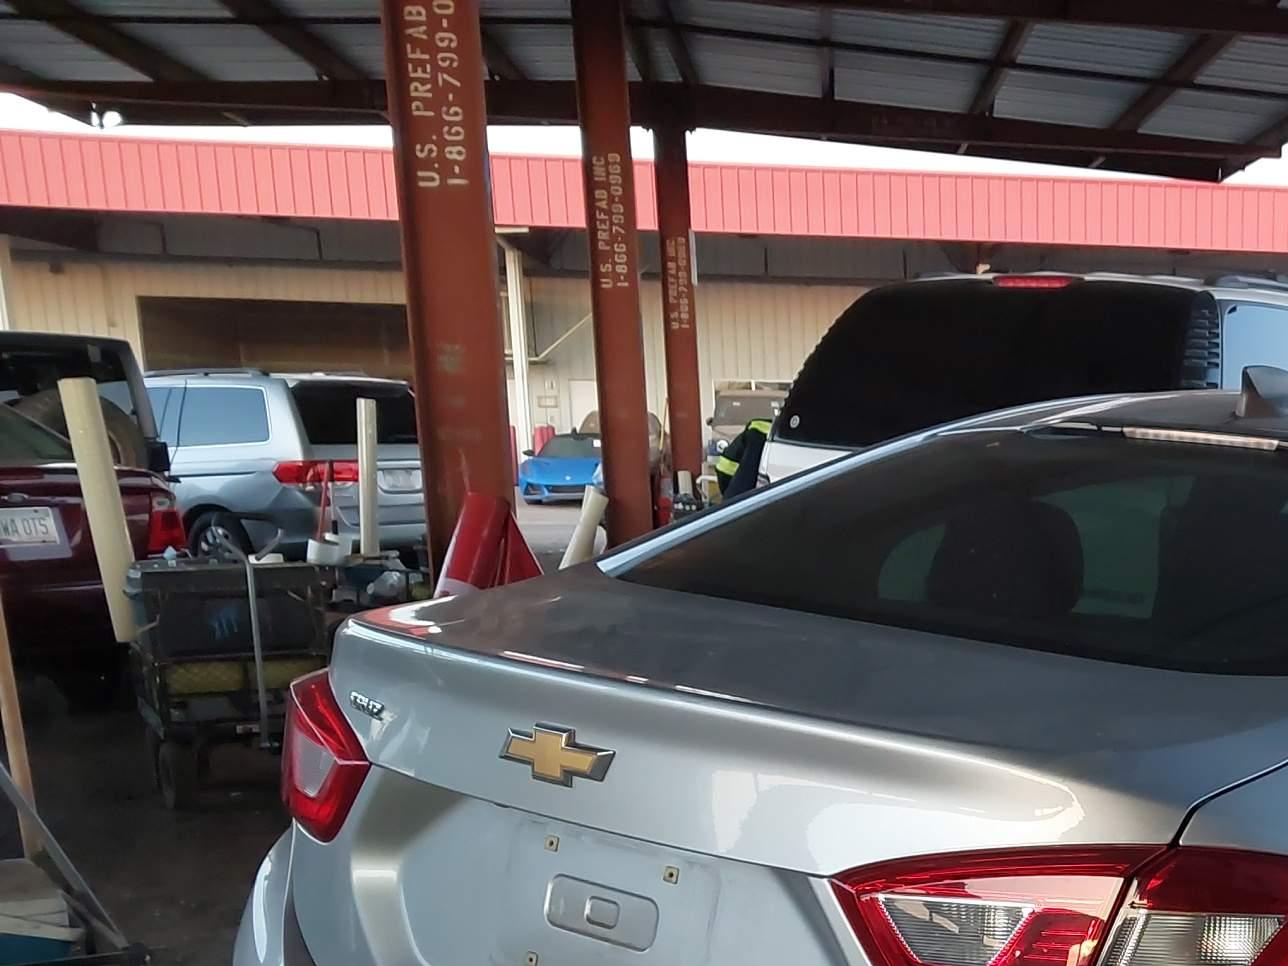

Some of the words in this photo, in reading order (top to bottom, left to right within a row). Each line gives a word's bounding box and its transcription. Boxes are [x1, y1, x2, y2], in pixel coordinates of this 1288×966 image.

[403, 5, 435, 117] PREFAB
[415, 134, 441, 188] U.S.
[592, 155, 607, 182] INC
[594, 189, 611, 250] PREFAB
[607, 152, 629, 288] 1-866-799-0969
